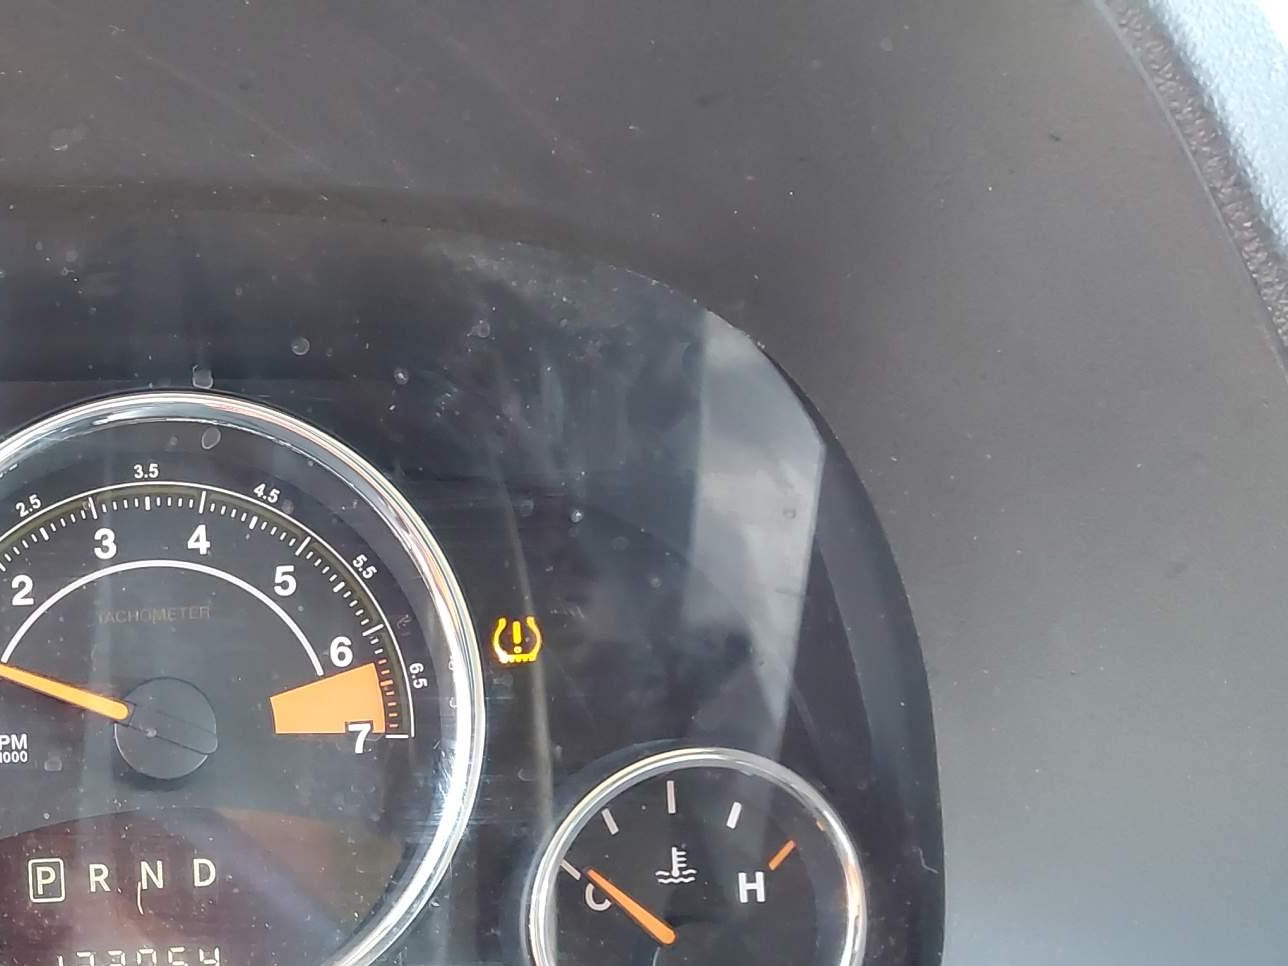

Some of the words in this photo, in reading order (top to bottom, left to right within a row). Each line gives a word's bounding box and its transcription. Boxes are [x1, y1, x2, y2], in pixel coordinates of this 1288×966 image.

[133, 464, 159, 478] 3.5
[15, 494, 41, 517] 2.5
[253, 483, 280, 503] 4.5
[94, 528, 117, 559] 3
[187, 525, 210, 555] 4
[274, 565, 297, 596] 5
[352, 554, 377, 579] 5.5
[12, 574, 35, 606] 2
[329, 636, 353, 667] 6
[410, 663, 428, 689] 6.5
[348, 723, 371, 754] 7
[36, 866, 56, 895] P
[89, 864, 111, 892] R
[140, 860, 163, 890] N
[193, 858, 216, 887] D
[738, 871, 765, 903] H
[585, 883, 612, 911] C
